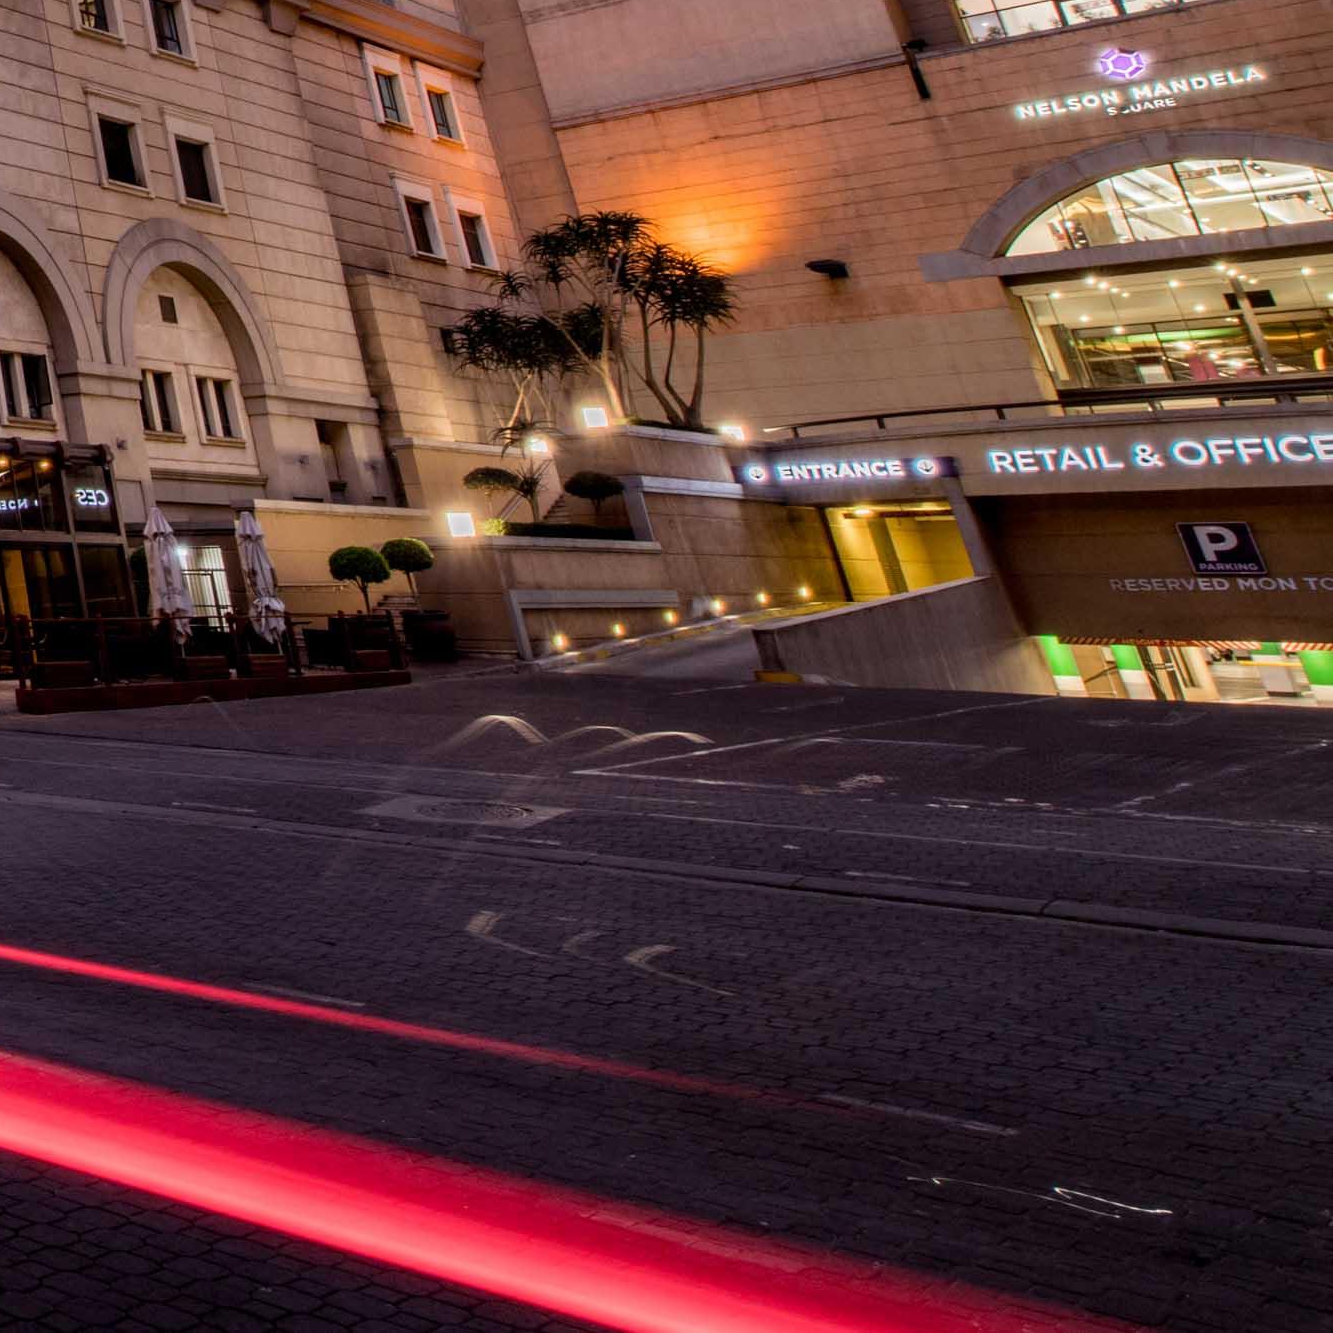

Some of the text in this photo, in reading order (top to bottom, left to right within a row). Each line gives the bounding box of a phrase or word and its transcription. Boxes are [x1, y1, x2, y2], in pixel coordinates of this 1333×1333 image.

[1016, 67, 1264, 119] NELSON MANDELA
[778, 460, 904, 480] ENTRANCE
[989, 446, 1124, 474] RETAIL
[1133, 442, 1165, 468] &
[1191, 525, 1238, 561] P
[1199, 562, 1259, 572] PARKING
[1109, 577, 1230, 593] RESERVED
[1237, 577, 1297, 592] MON
